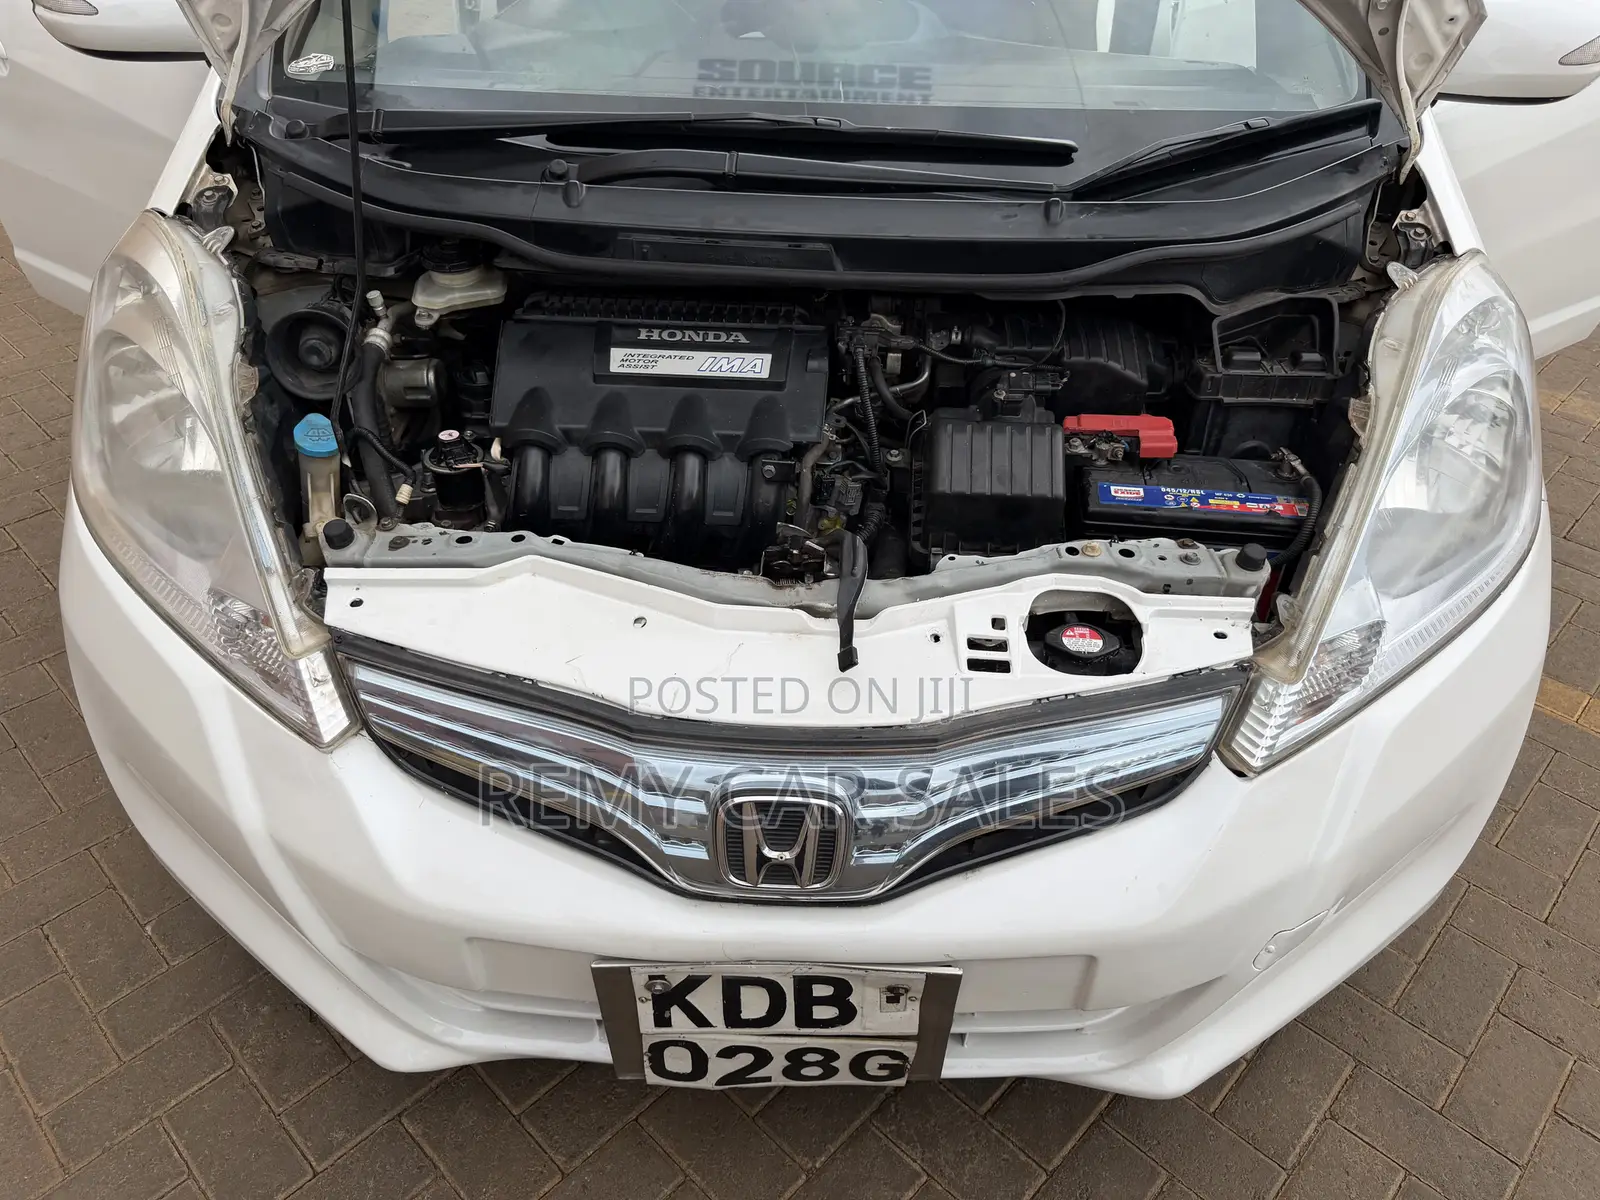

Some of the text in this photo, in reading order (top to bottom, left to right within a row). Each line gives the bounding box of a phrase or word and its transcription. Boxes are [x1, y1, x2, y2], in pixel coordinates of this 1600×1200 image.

[697, 58, 933, 91] SOURCE
[637, 328, 750, 343] HONDA
[623, 353, 695, 361] INTEGRATED
[697, 357, 764, 374] IMA
[647, 974, 858, 1029] KDB
[647, 1039, 911, 1087] 028G
